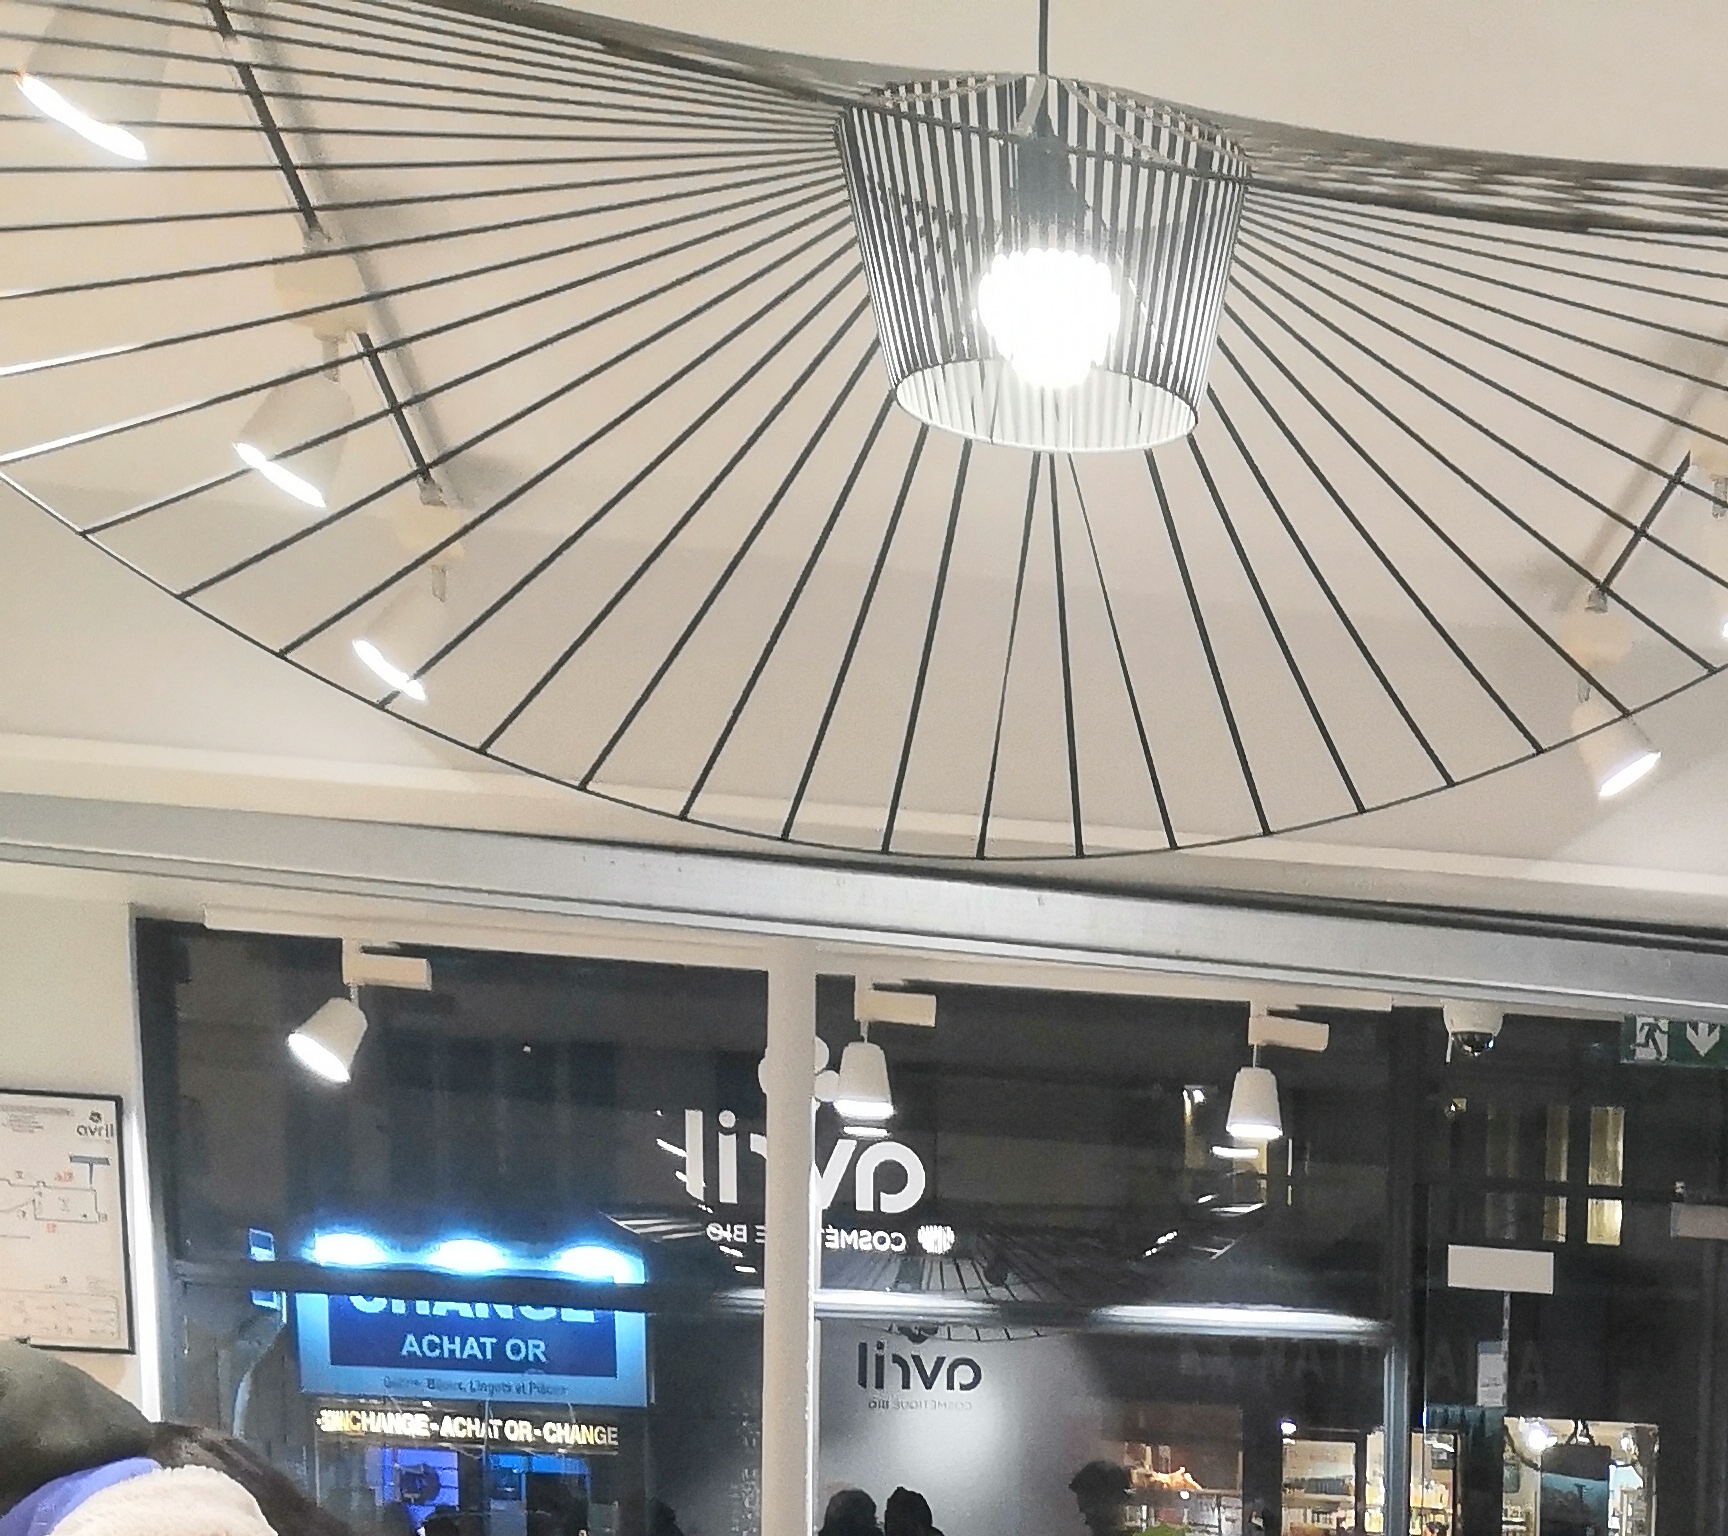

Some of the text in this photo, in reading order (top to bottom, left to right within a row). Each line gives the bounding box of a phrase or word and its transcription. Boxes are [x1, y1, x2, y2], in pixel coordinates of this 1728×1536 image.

[76, 1122, 114, 1139] avril
[401, 1334, 548, 1363] ACHAT OR
[504, 1419, 533, 1442] OR
[542, 1421, 618, 1445] CHANGE
